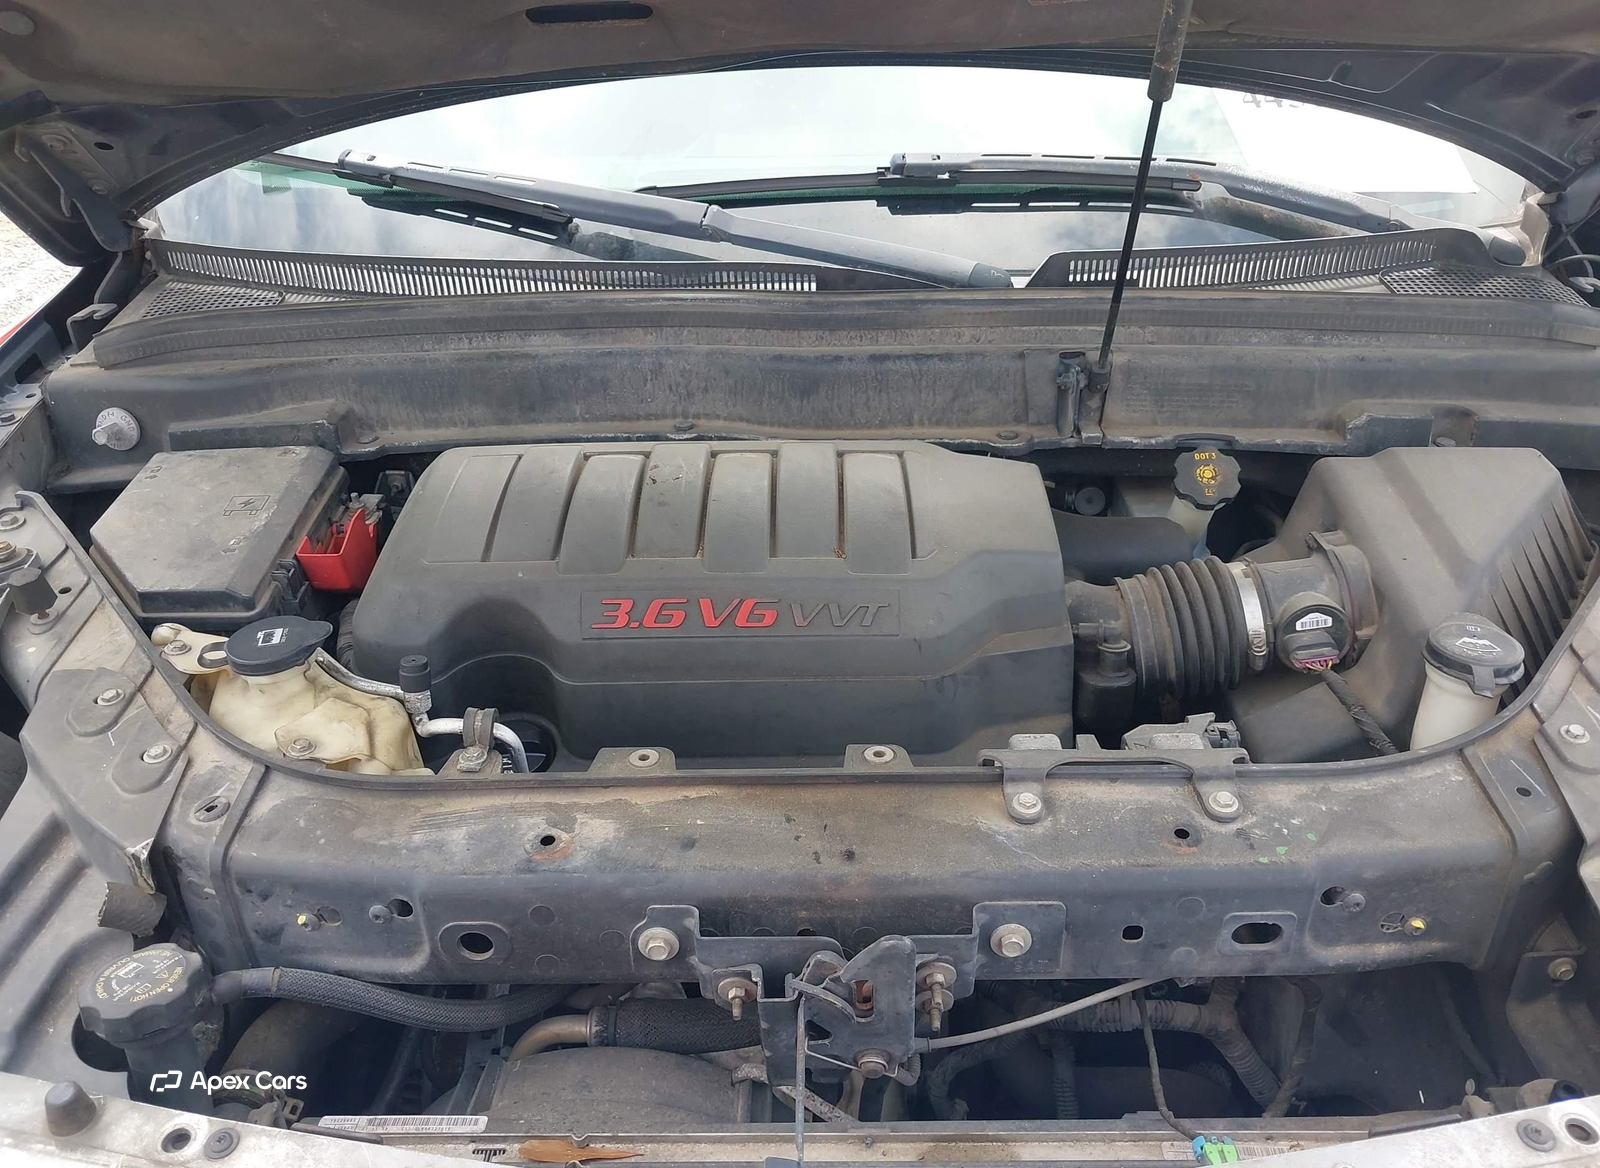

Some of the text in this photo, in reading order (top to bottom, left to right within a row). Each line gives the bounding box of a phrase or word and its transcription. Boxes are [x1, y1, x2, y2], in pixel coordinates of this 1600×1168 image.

[591, 598, 890, 629] 3.6 V6 VVT
[149, 983, 170, 996] OPEN
